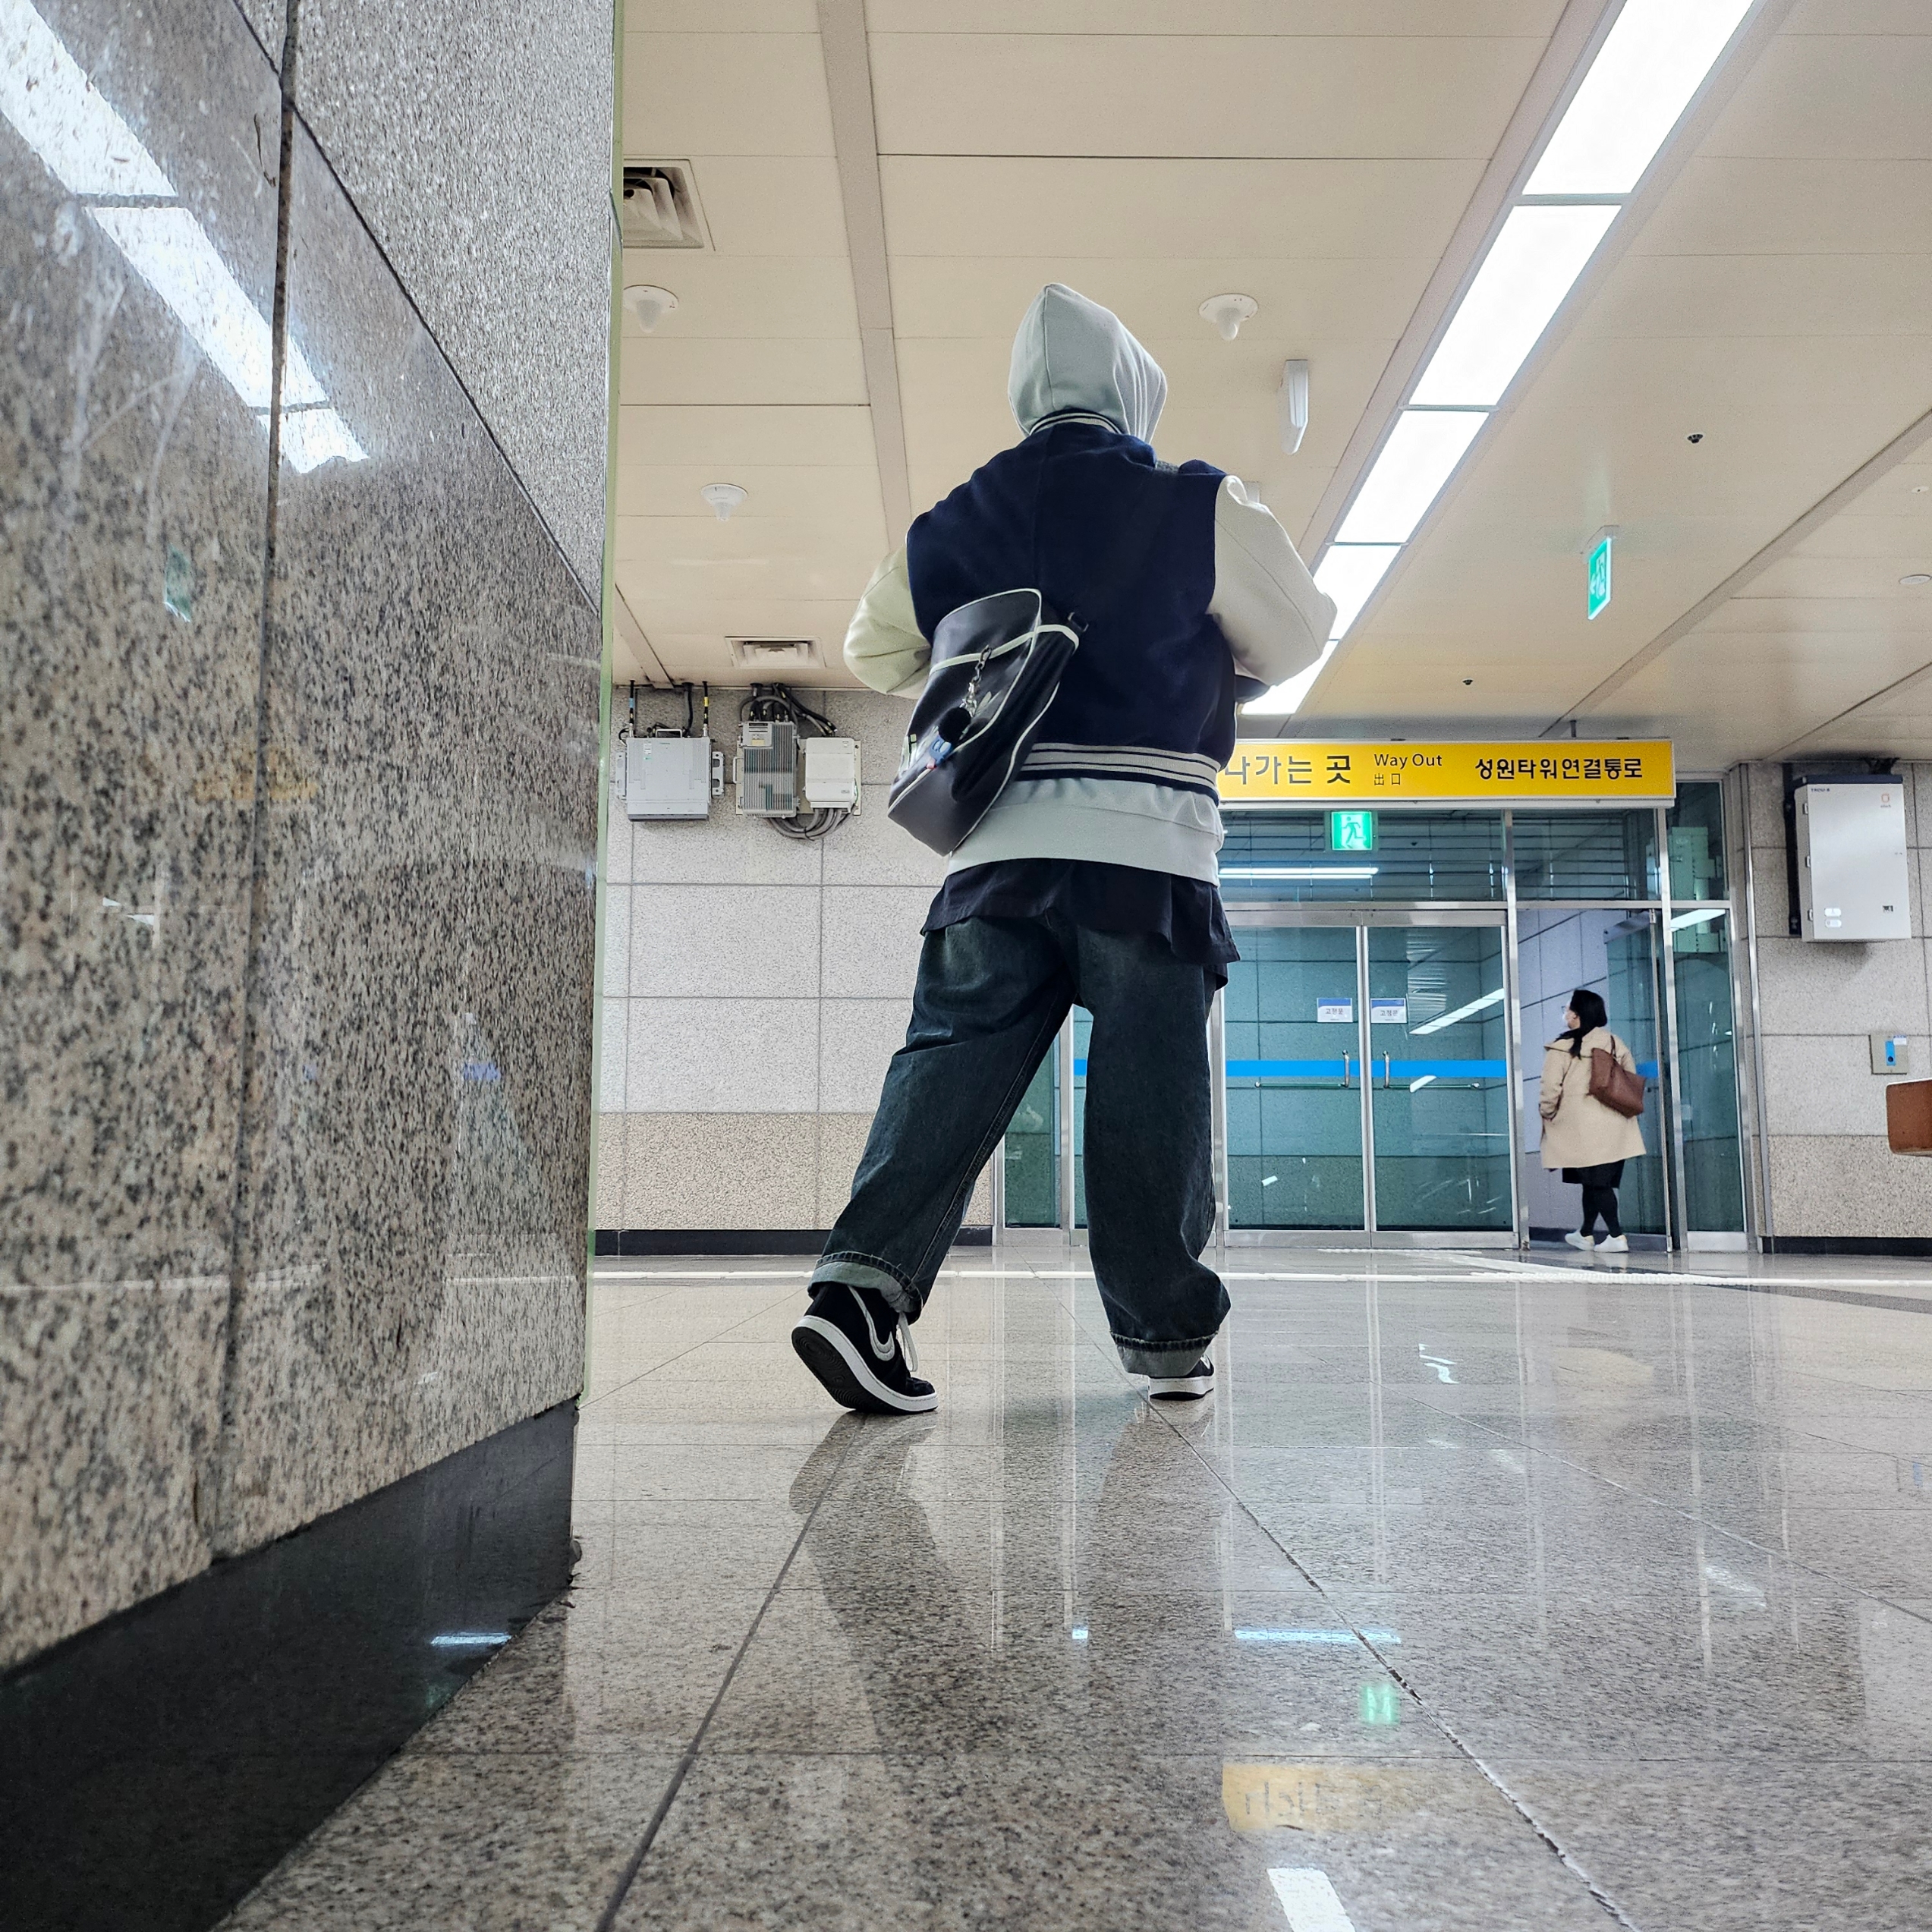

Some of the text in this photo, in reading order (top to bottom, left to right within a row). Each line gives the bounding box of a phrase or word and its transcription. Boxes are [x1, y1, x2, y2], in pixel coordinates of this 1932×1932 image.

[1374, 754, 1443, 769] Way Out
[1224, 756, 1351, 785] 나가는 곳
[1374, 773, 1401, 785] 出口
